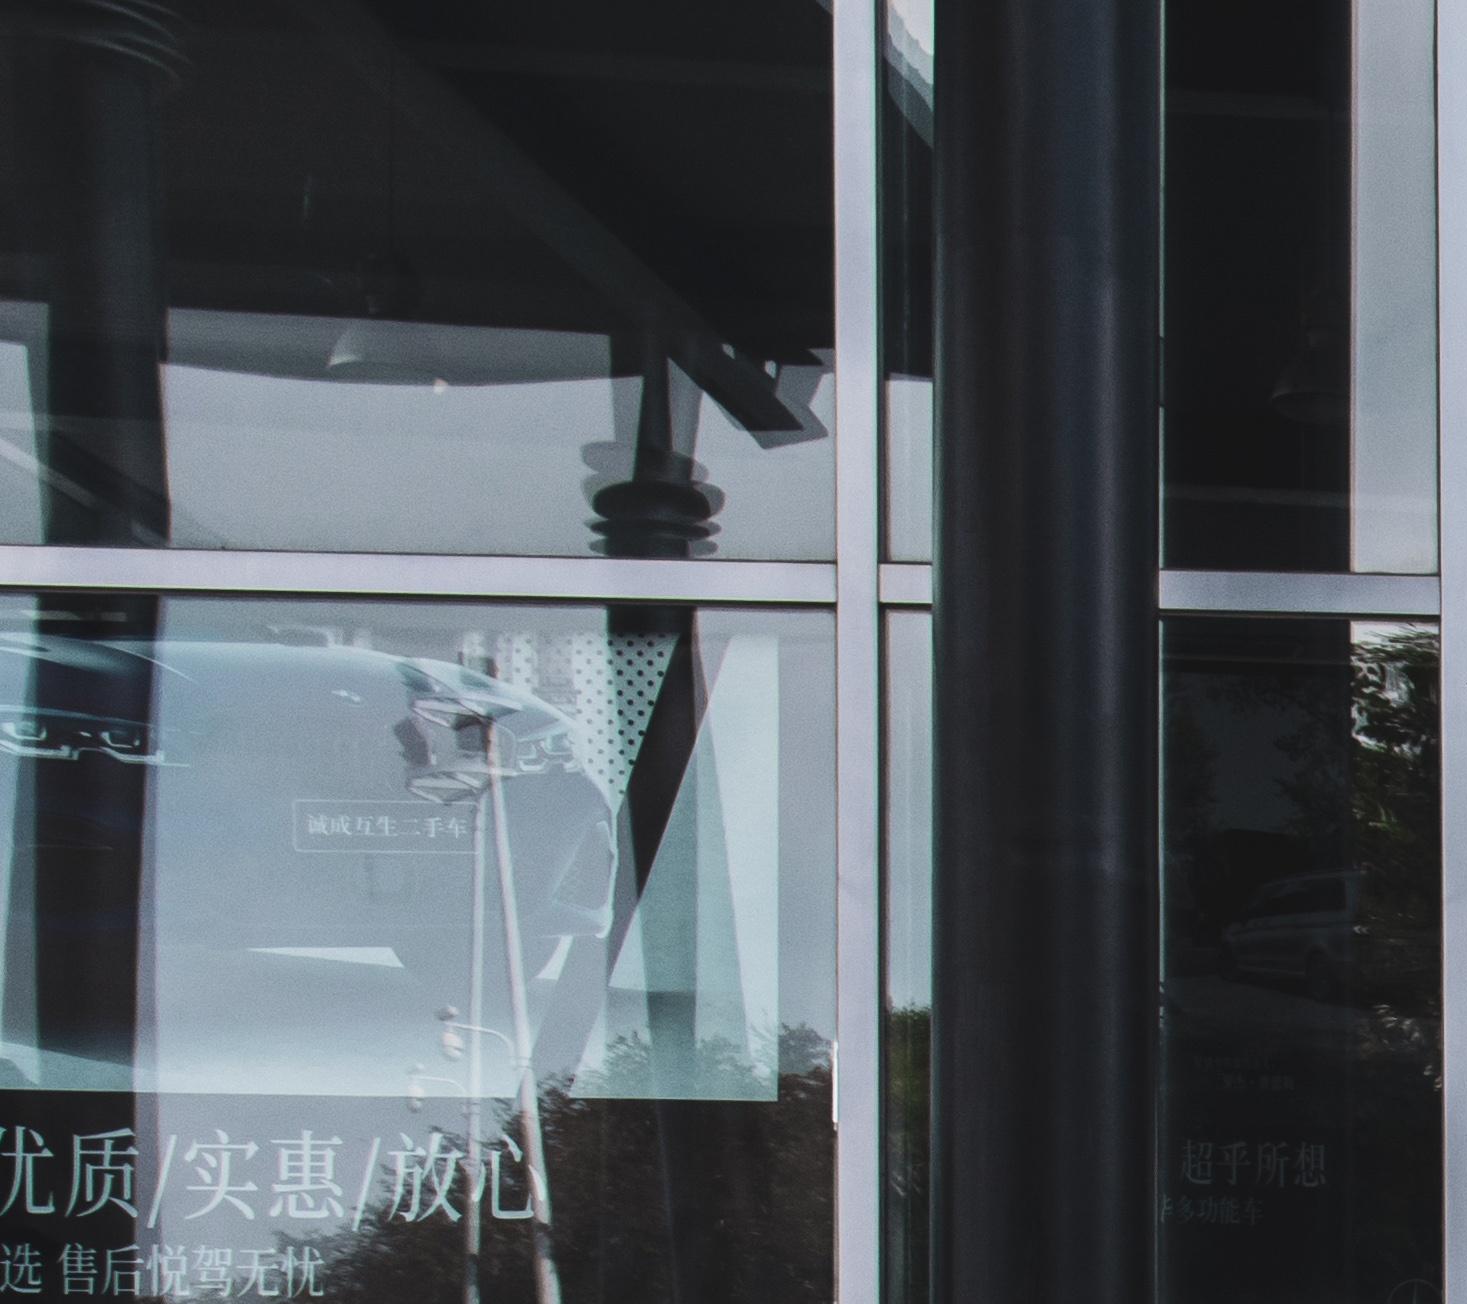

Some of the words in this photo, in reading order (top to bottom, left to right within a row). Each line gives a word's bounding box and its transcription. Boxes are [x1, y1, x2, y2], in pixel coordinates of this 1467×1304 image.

[0, 1125, 544, 1231] 优质/实惠/放心
[1179, 1139, 1327, 1188] 超乎所想
[59, 1243, 325, 1297] 售后悦驾无忧
